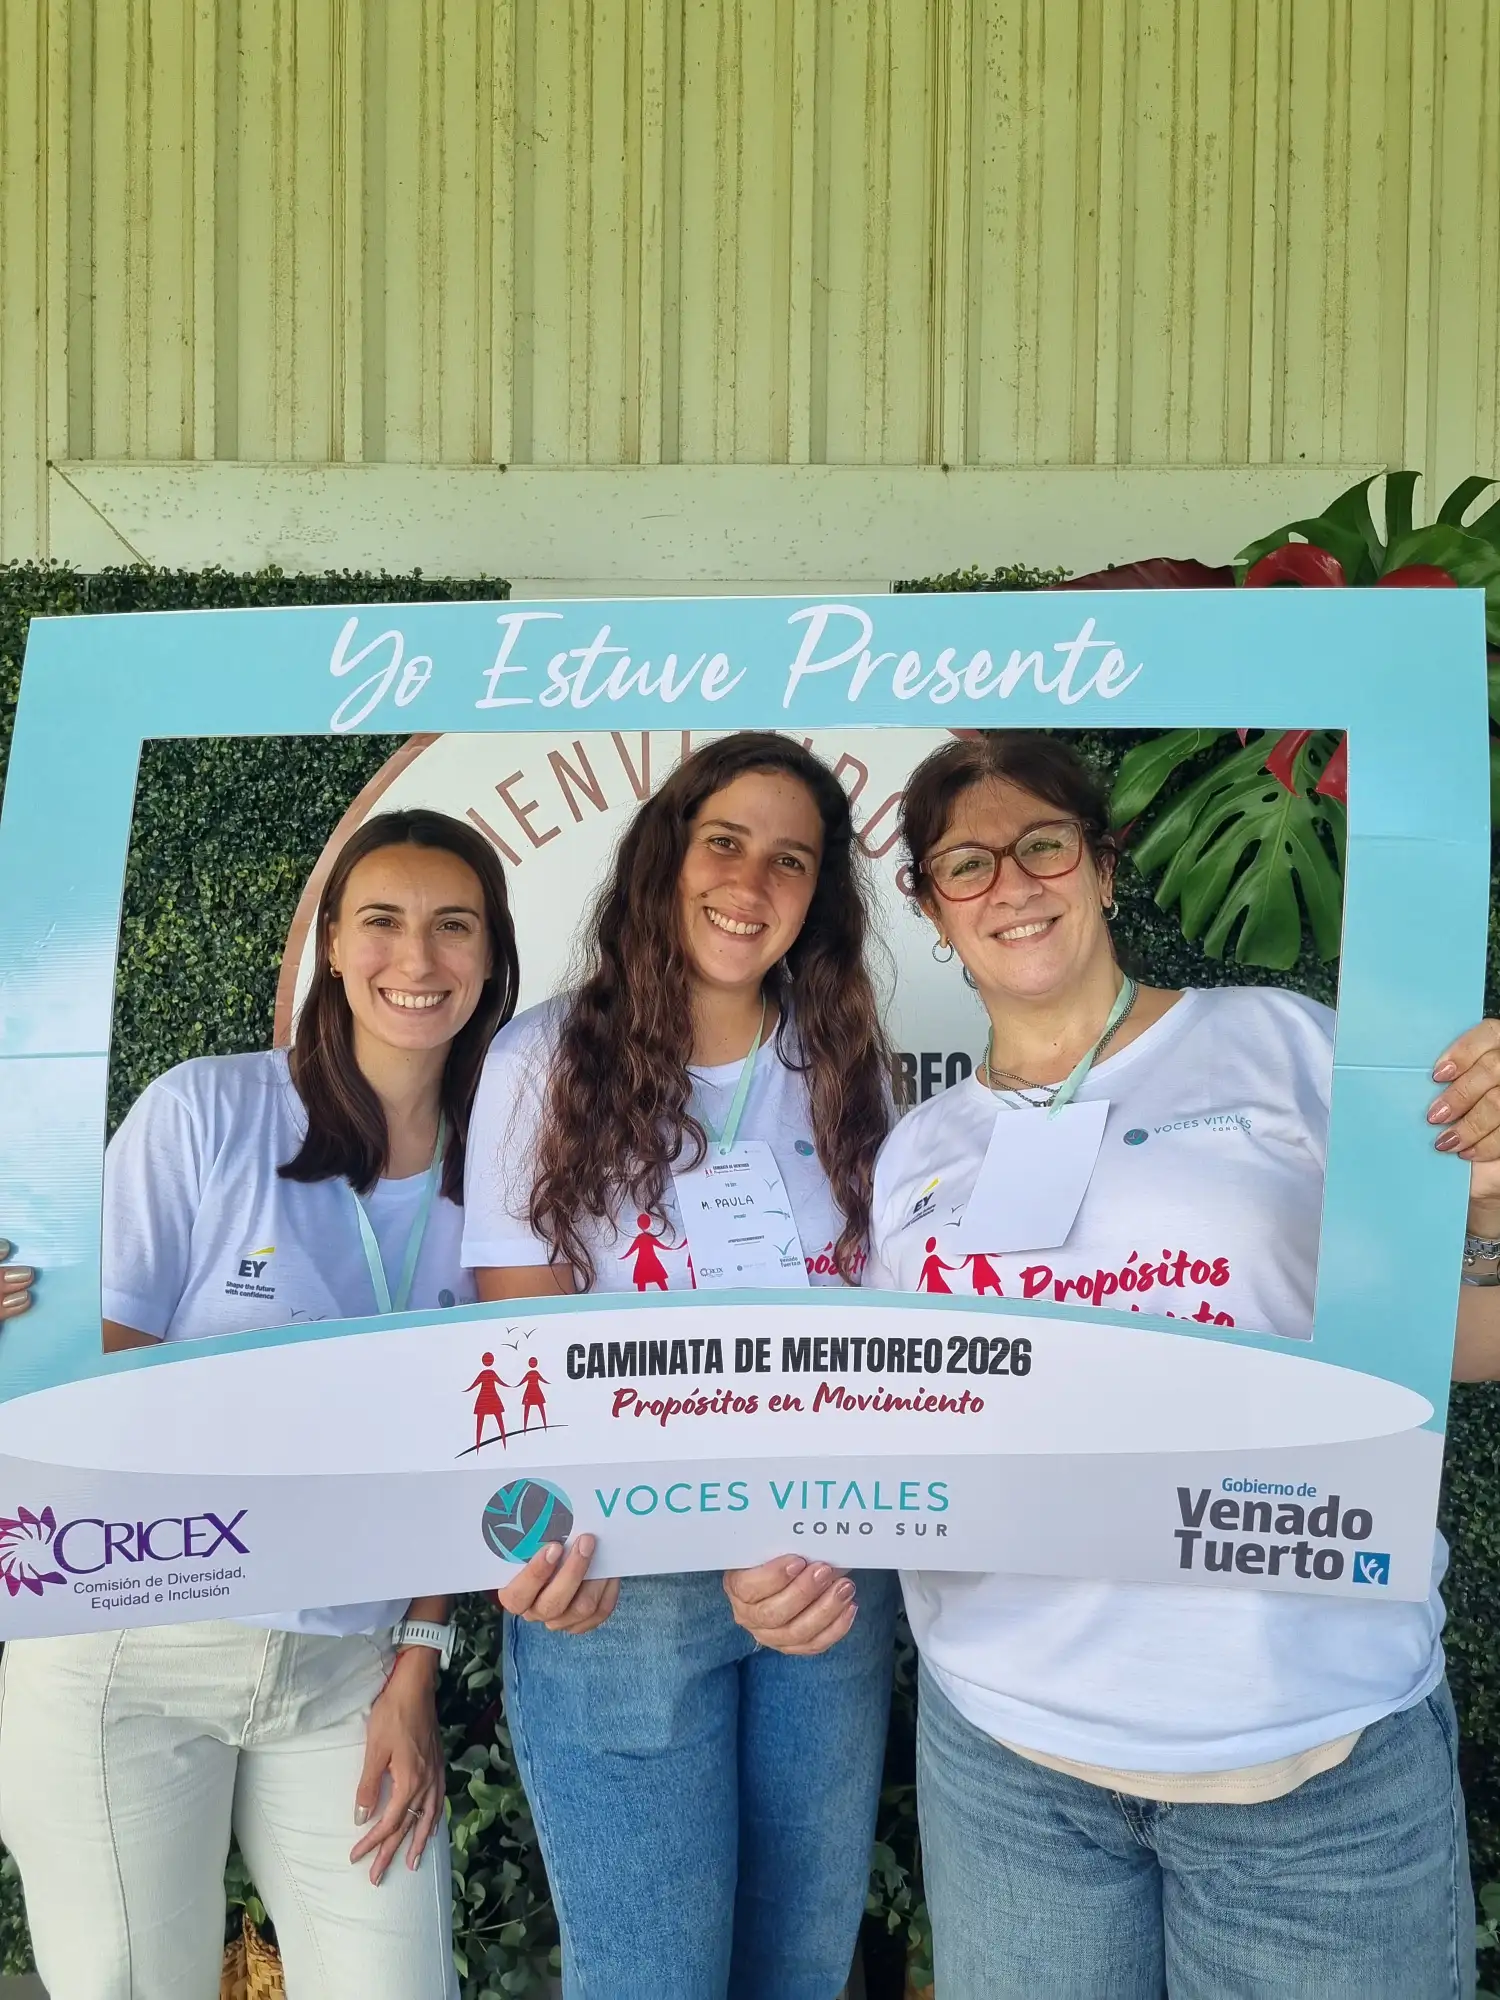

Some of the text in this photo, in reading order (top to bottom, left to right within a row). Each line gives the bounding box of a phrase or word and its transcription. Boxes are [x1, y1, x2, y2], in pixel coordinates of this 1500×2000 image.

[330, 604, 1143, 733] Yo Estuve Presente
[1154, 1119, 1199, 1134] VOCES
[701, 1195, 754, 1210] M. PAULA
[913, 1191, 934, 1215] EY
[238, 1259, 268, 1278] EY
[1019, 1249, 1230, 1306] Propósitos
[226, 1280, 244, 1290] Shape
[240, 1291, 275, 1300] confidence
[566, 1336, 1032, 1380] CAMINATA DE MENTOREO 2026
[612, 1382, 985, 1427] Propósitos en Movimiento
[595, 1480, 949, 1518] VOCES VITALES
[1222, 1477, 1317, 1498] Gobierno de
[1176, 1486, 1373, 1540] Venado
[53, 1509, 250, 1574] CRICEX
[793, 1521, 948, 1537] CONO SUR
[1174, 1529, 1345, 1580] Tuerto
[73, 1566, 247, 1595] Comisión de Diversidad,
[91, 1585, 230, 1610] Equidad e Inclusión
